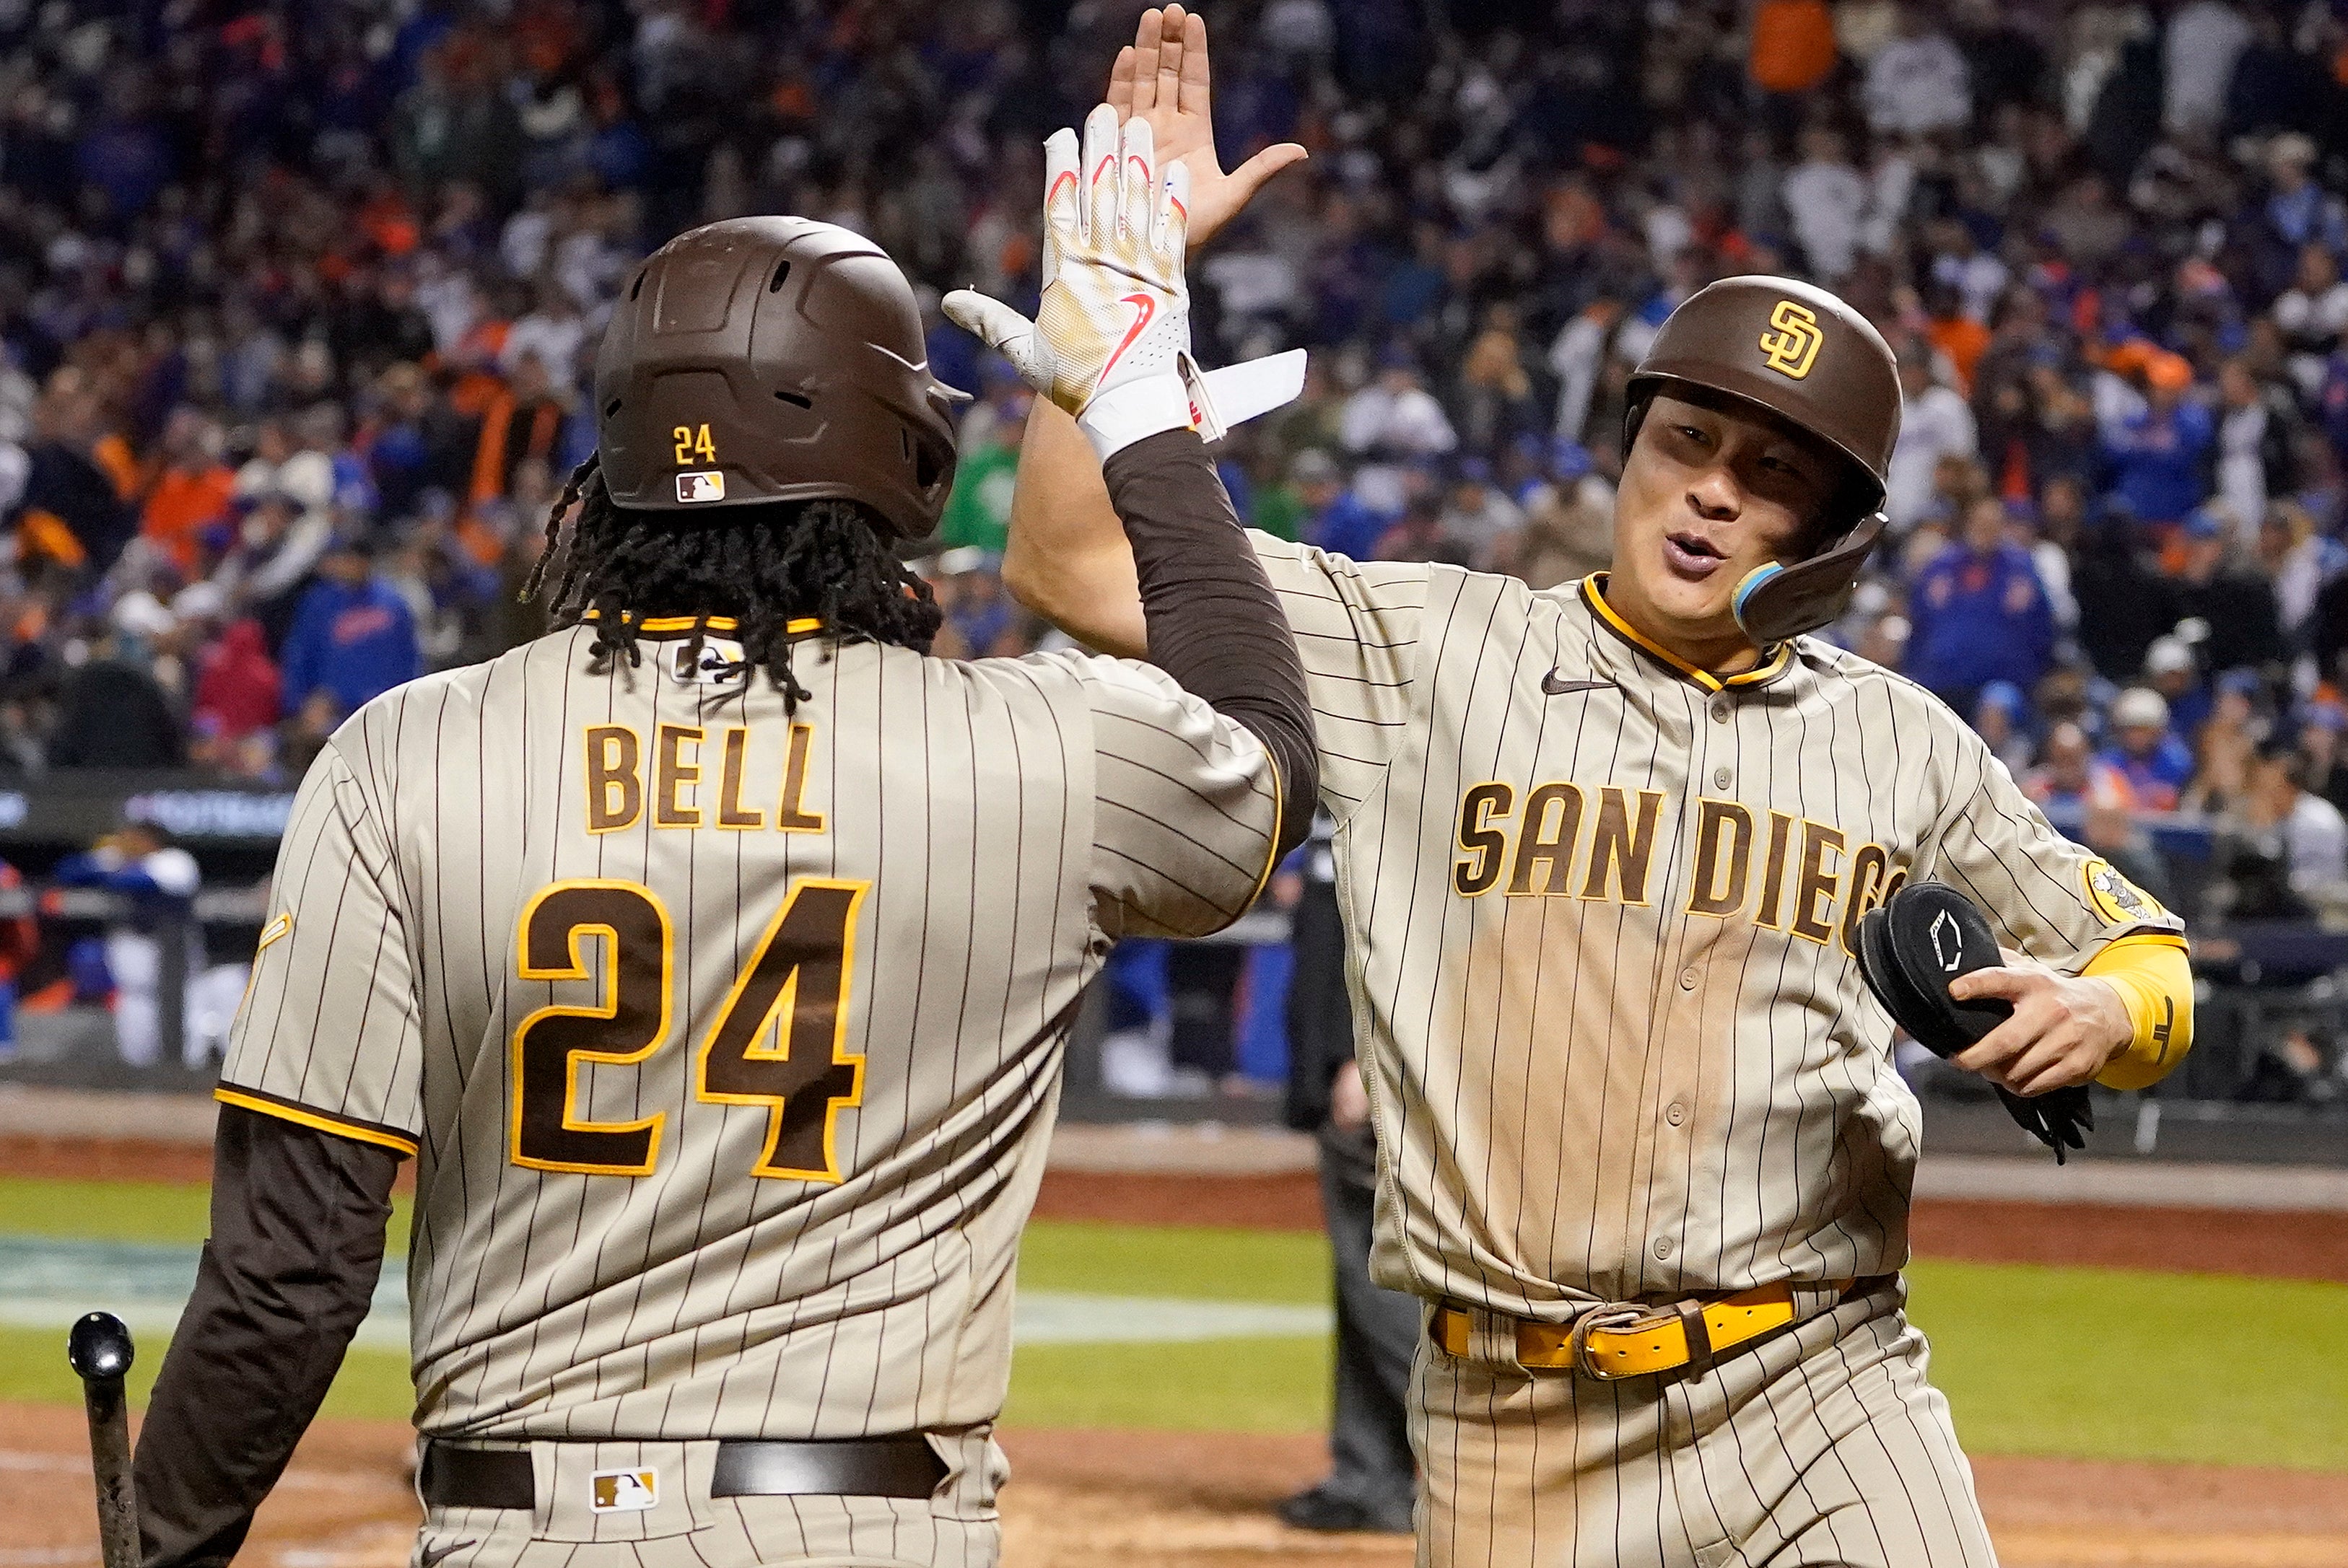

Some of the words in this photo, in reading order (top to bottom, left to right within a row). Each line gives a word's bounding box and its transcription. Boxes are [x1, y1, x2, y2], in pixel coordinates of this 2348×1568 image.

[1760, 299, 1823, 379] SD
[673, 424, 716, 465] 24
[583, 723, 826, 834] BELL
[1454, 781, 1667, 906] SAN
[510, 877, 872, 1184] 24
